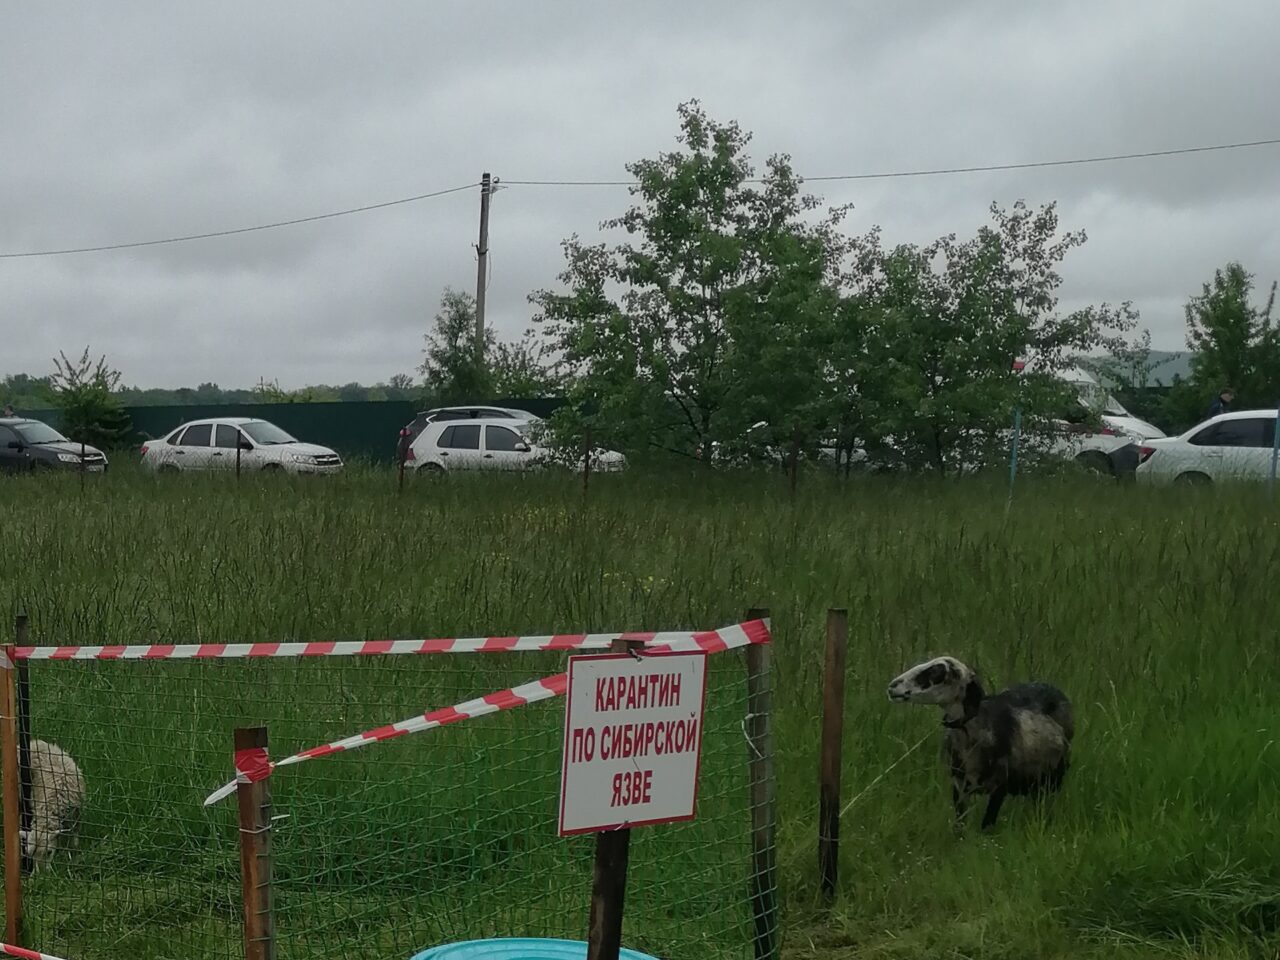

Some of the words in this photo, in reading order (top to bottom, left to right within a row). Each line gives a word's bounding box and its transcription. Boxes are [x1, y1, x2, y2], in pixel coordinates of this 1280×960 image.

[594, 673, 682, 713] КАРАНТИН
[571, 727, 596, 763] ПО
[600, 712, 698, 760] СИБИРСКОЙ
[610, 770, 653, 807] ЯЗВЕ
